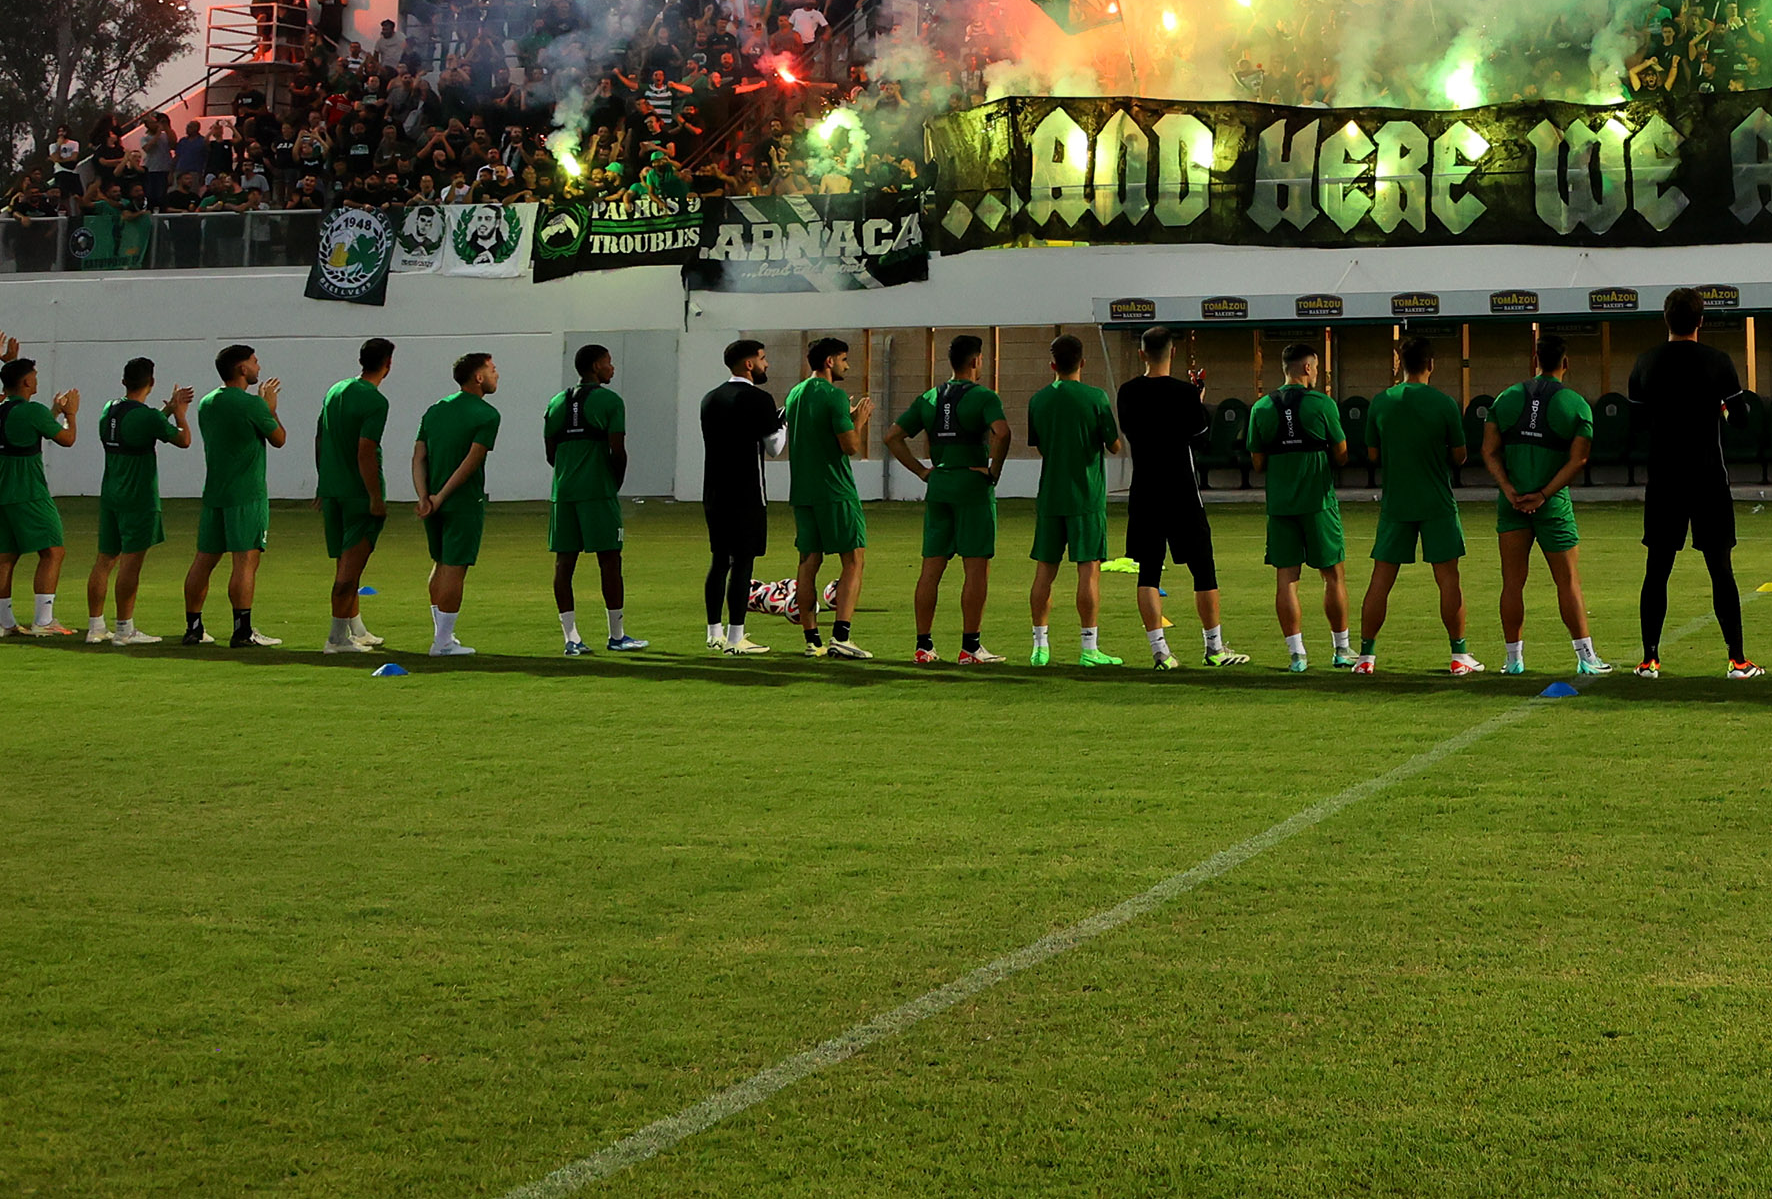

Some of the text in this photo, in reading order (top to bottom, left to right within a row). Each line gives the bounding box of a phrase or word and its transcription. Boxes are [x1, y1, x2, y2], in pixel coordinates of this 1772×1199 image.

[1246, 119, 1491, 235] HERE
[1527, 115, 1690, 236] WE
[343, 217, 372, 231] 1948
[699, 212, 923, 261] ARNACA
[1492, 293, 1536, 304] TOMAZOU
[1591, 291, 1636, 302] TOMAZOU
[1698, 288, 1737, 299] MAZOU
[1204, 299, 1246, 310] TOMAZOU
[1297, 297, 1341, 308] TOMAZOU
[1393, 295, 1437, 306] TOMAZOU
[1112, 301, 1153, 312] TOMAZOU
[1529, 400, 1540, 429] gpexe
[1285, 408, 1294, 437] gpexe
